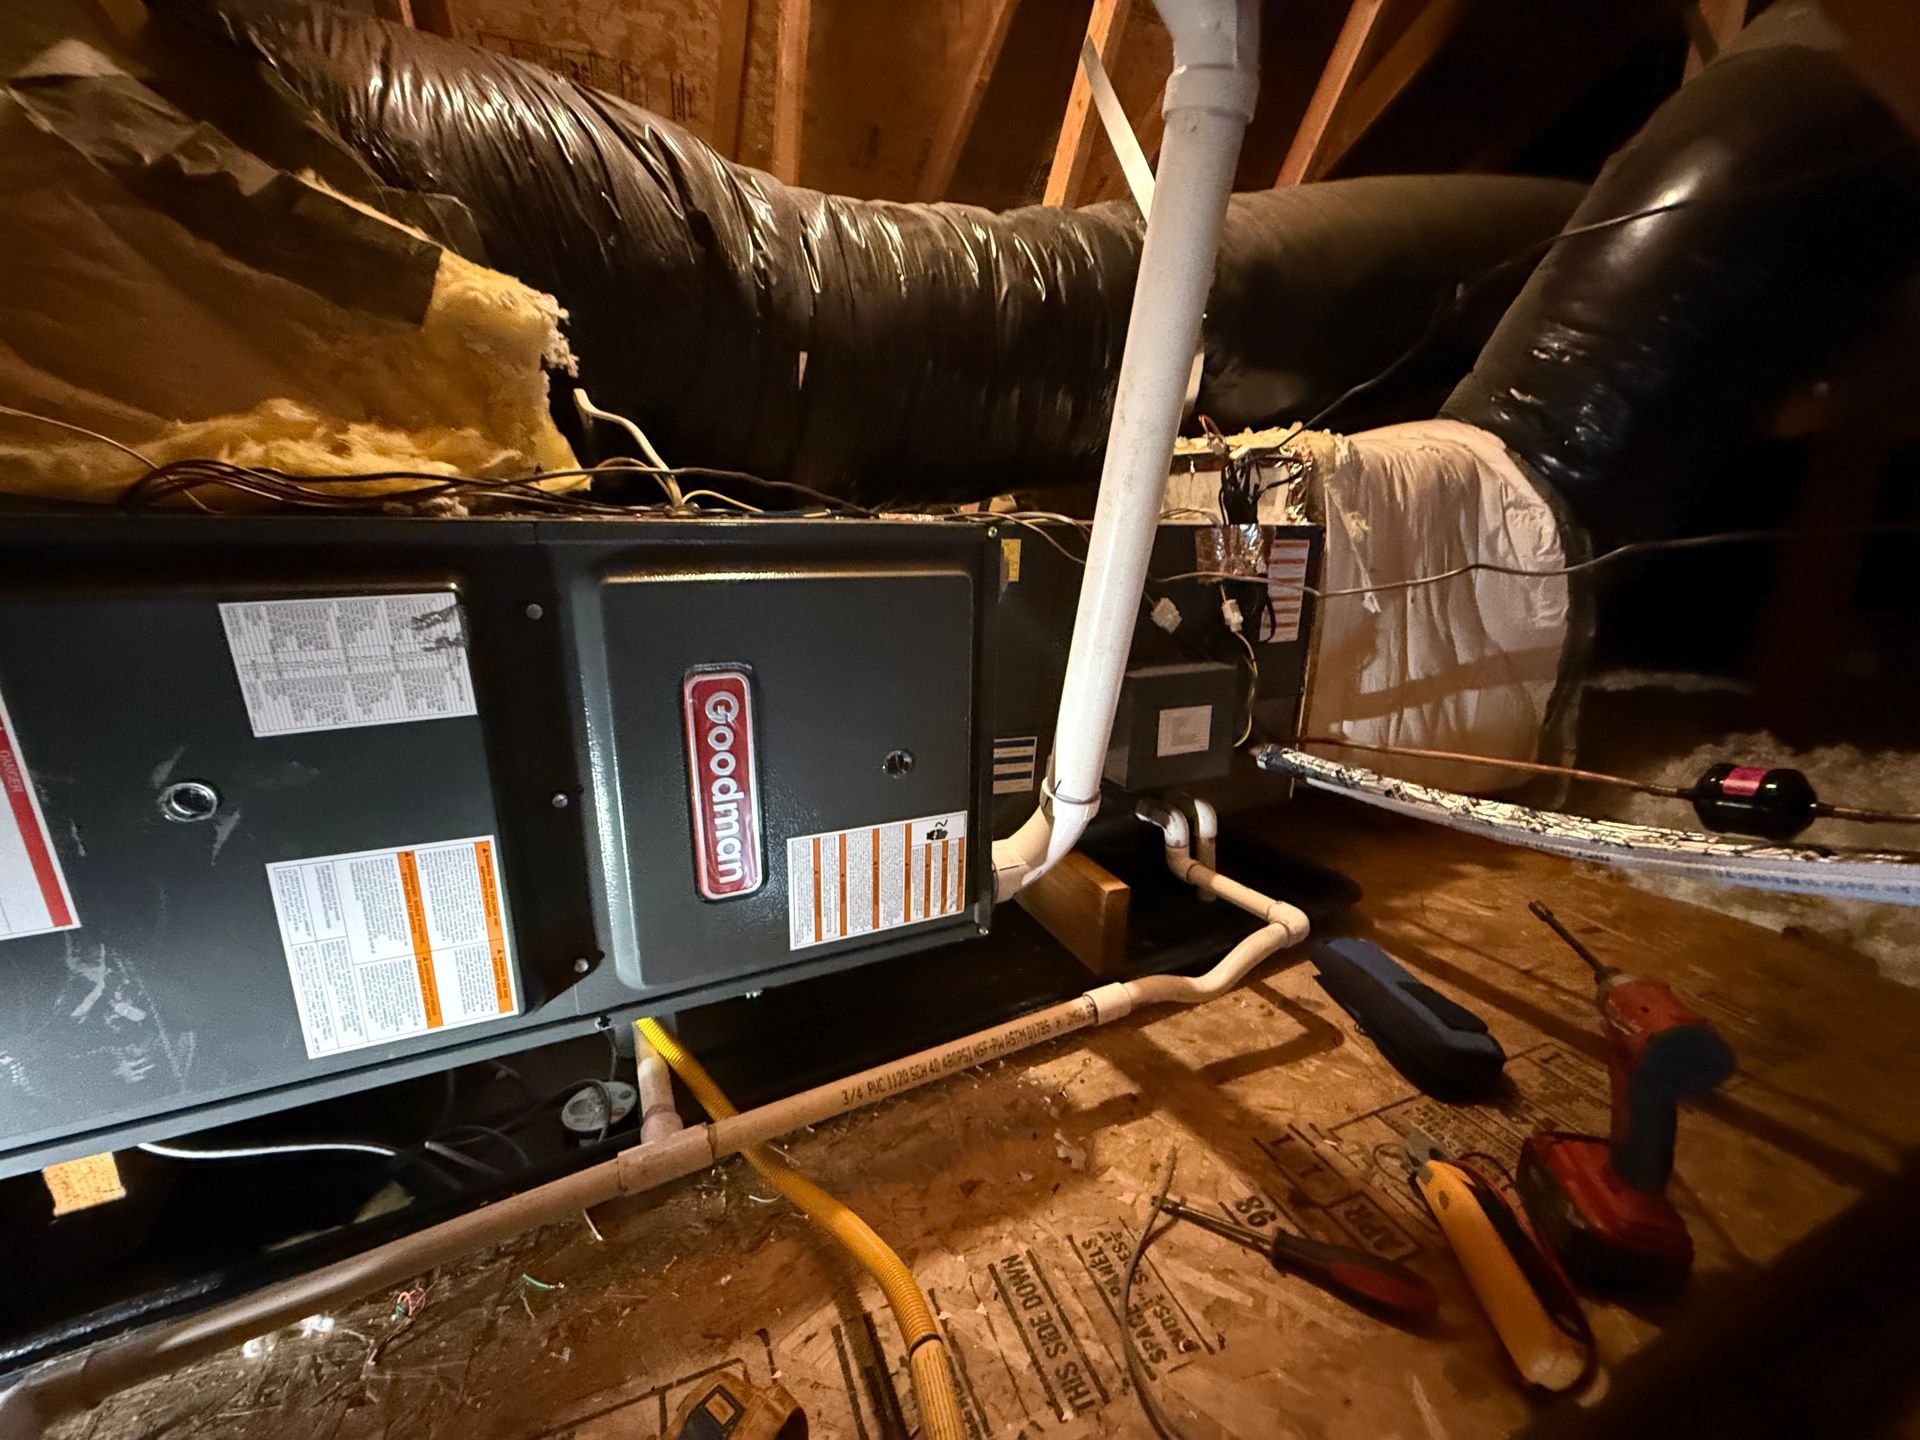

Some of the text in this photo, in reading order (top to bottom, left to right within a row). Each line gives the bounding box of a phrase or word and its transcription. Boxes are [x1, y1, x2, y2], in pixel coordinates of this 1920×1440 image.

[0, 749, 24, 793] DANGER
[705, 691, 744, 883] Goodman
[840, 1085, 864, 1105] 3/4
[865, 1077, 886, 1097] PVC
[885, 1068, 909, 1090] 1120
[907, 1063, 928, 1082] SCH
[927, 1057, 941, 1075] 40
[1003, 1027, 1027, 1048] ASTM
[1343, 1201, 1405, 1257] APR
[999, 1252, 1097, 1417] THIS SIDE DOWN
[1124, 1302, 1170, 1365] SPACE
